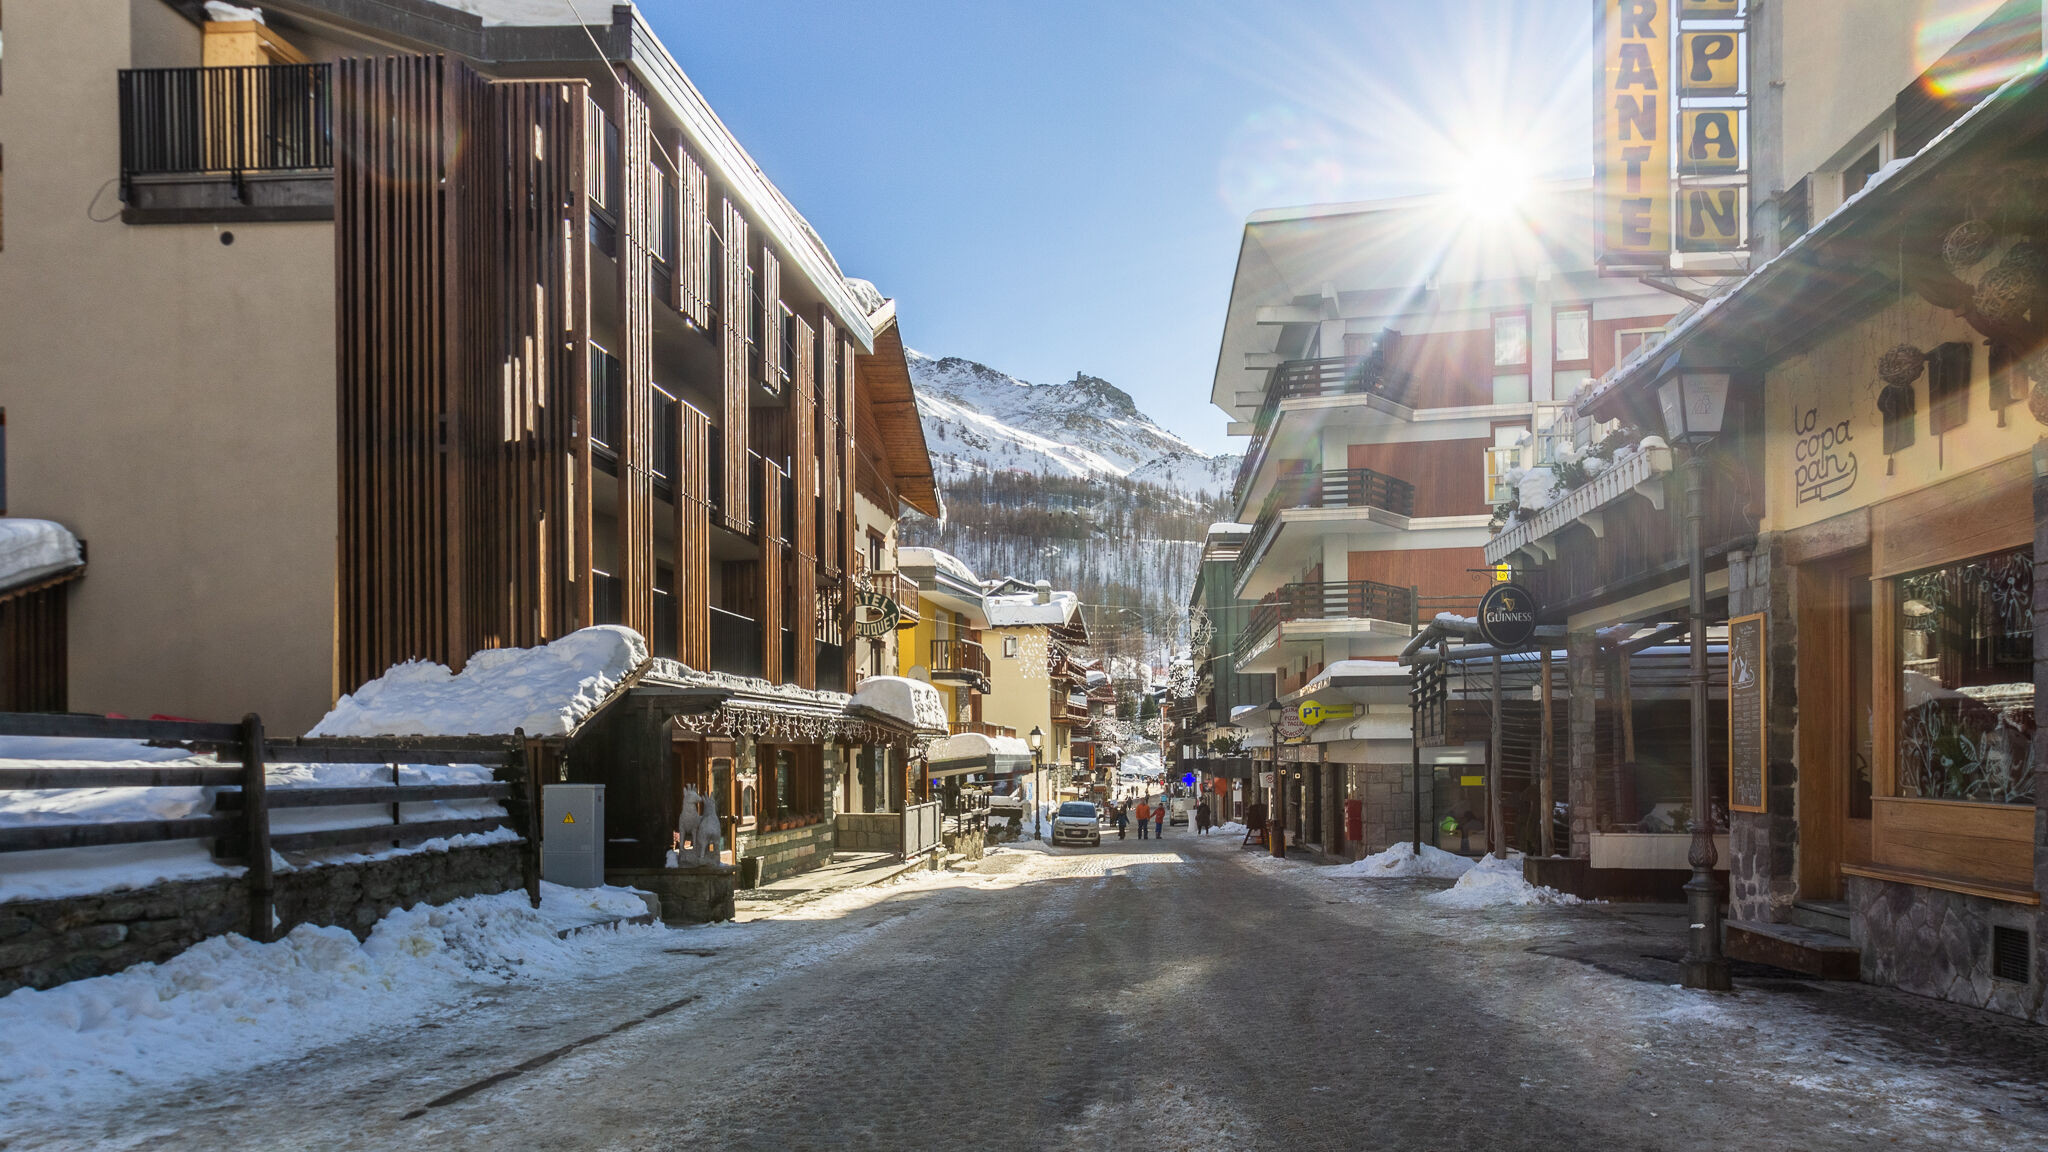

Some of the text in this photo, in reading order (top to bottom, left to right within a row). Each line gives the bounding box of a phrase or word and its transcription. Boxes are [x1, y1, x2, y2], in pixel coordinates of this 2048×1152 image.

[1614, 0, 1658, 246] RANTE
[1688, 0, 1737, 237] PAN
[1795, 404, 1817, 436] la
[1796, 419, 1853, 471] capa
[1795, 454, 1848, 508] pan
[855, 593, 888, 612] OTEL
[1487, 612, 1532, 623] GUINNESS
[856, 613, 895, 635] RUQUET
[1303, 706, 1321, 719] PT
